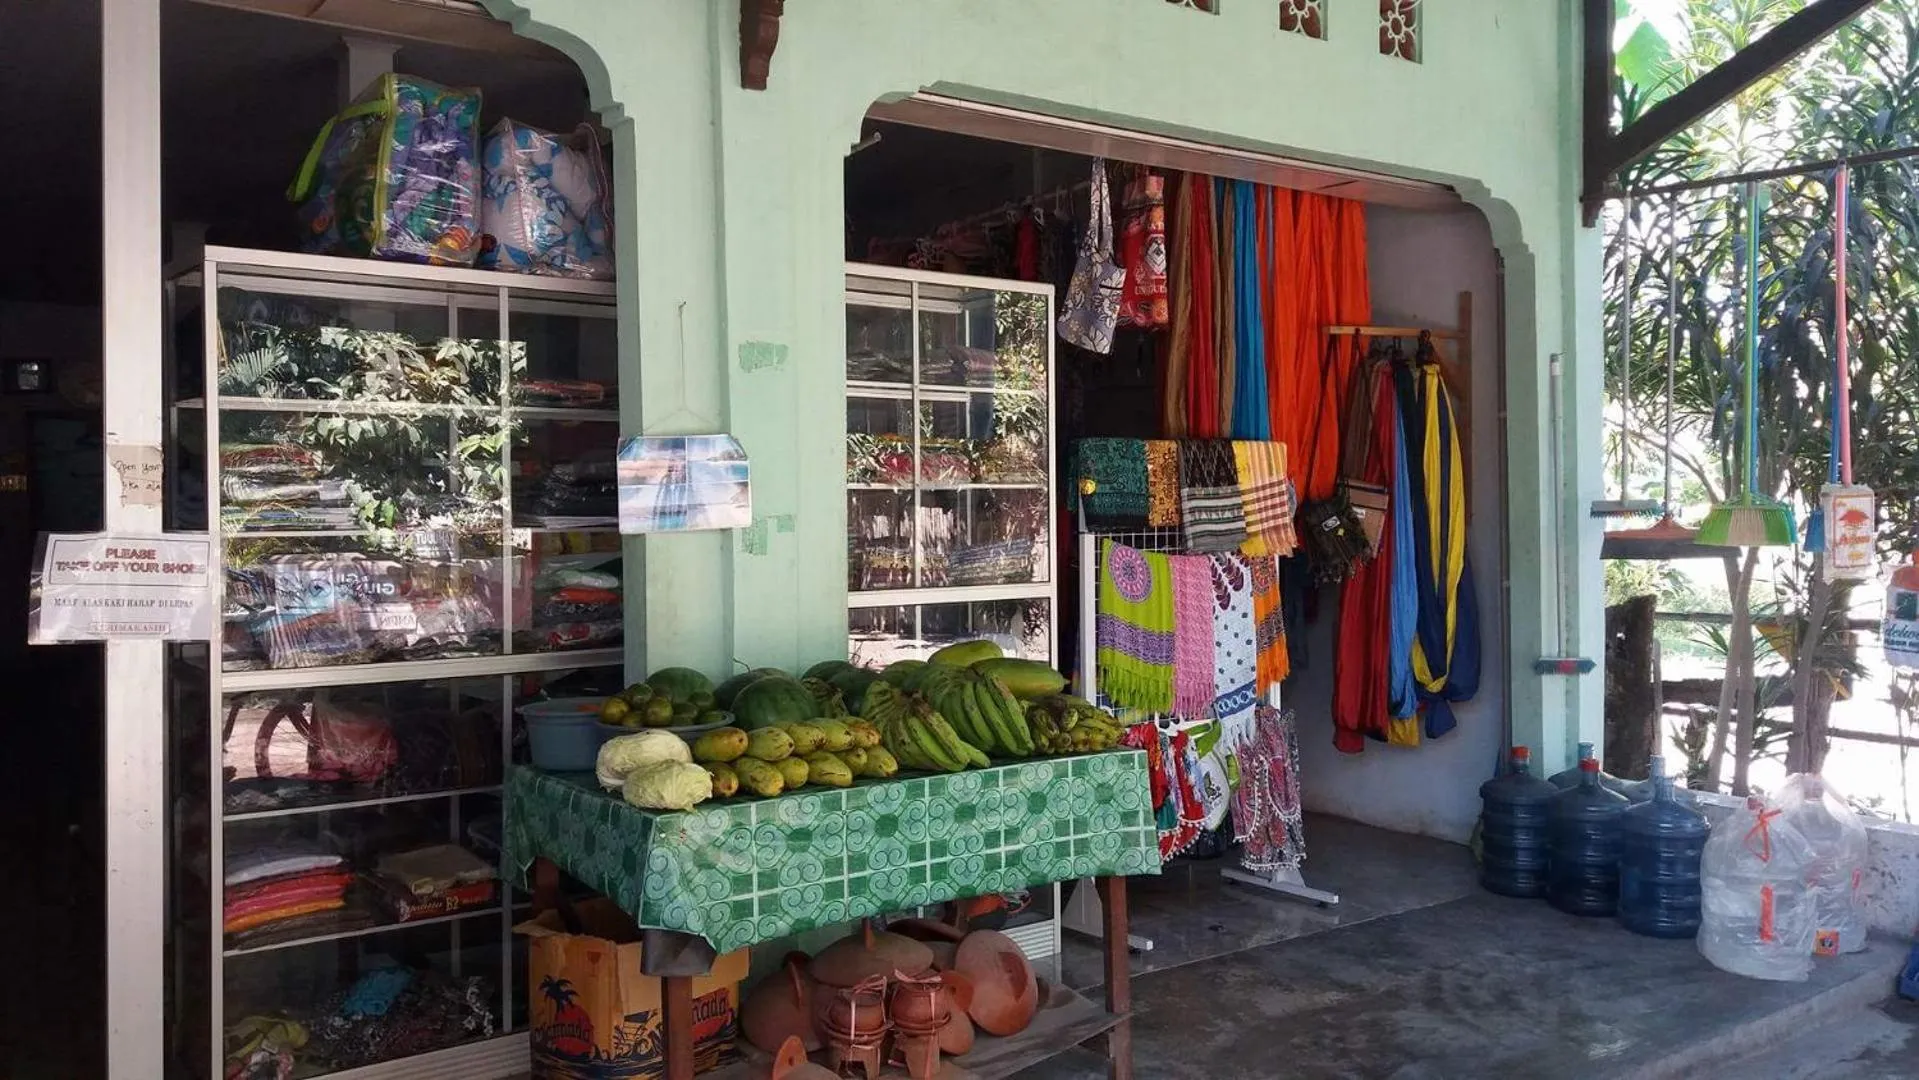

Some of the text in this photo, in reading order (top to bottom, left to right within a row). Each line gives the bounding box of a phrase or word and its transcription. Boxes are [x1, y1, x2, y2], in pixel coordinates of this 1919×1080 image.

[105, 547, 157, 560] PLEASE
[55, 560, 90, 572] TAKE
[92, 561, 119, 573] OFF
[121, 561, 160, 574] YOUR
[104, 599, 125, 609] KAKI
[126, 600, 154, 609] HARAP
